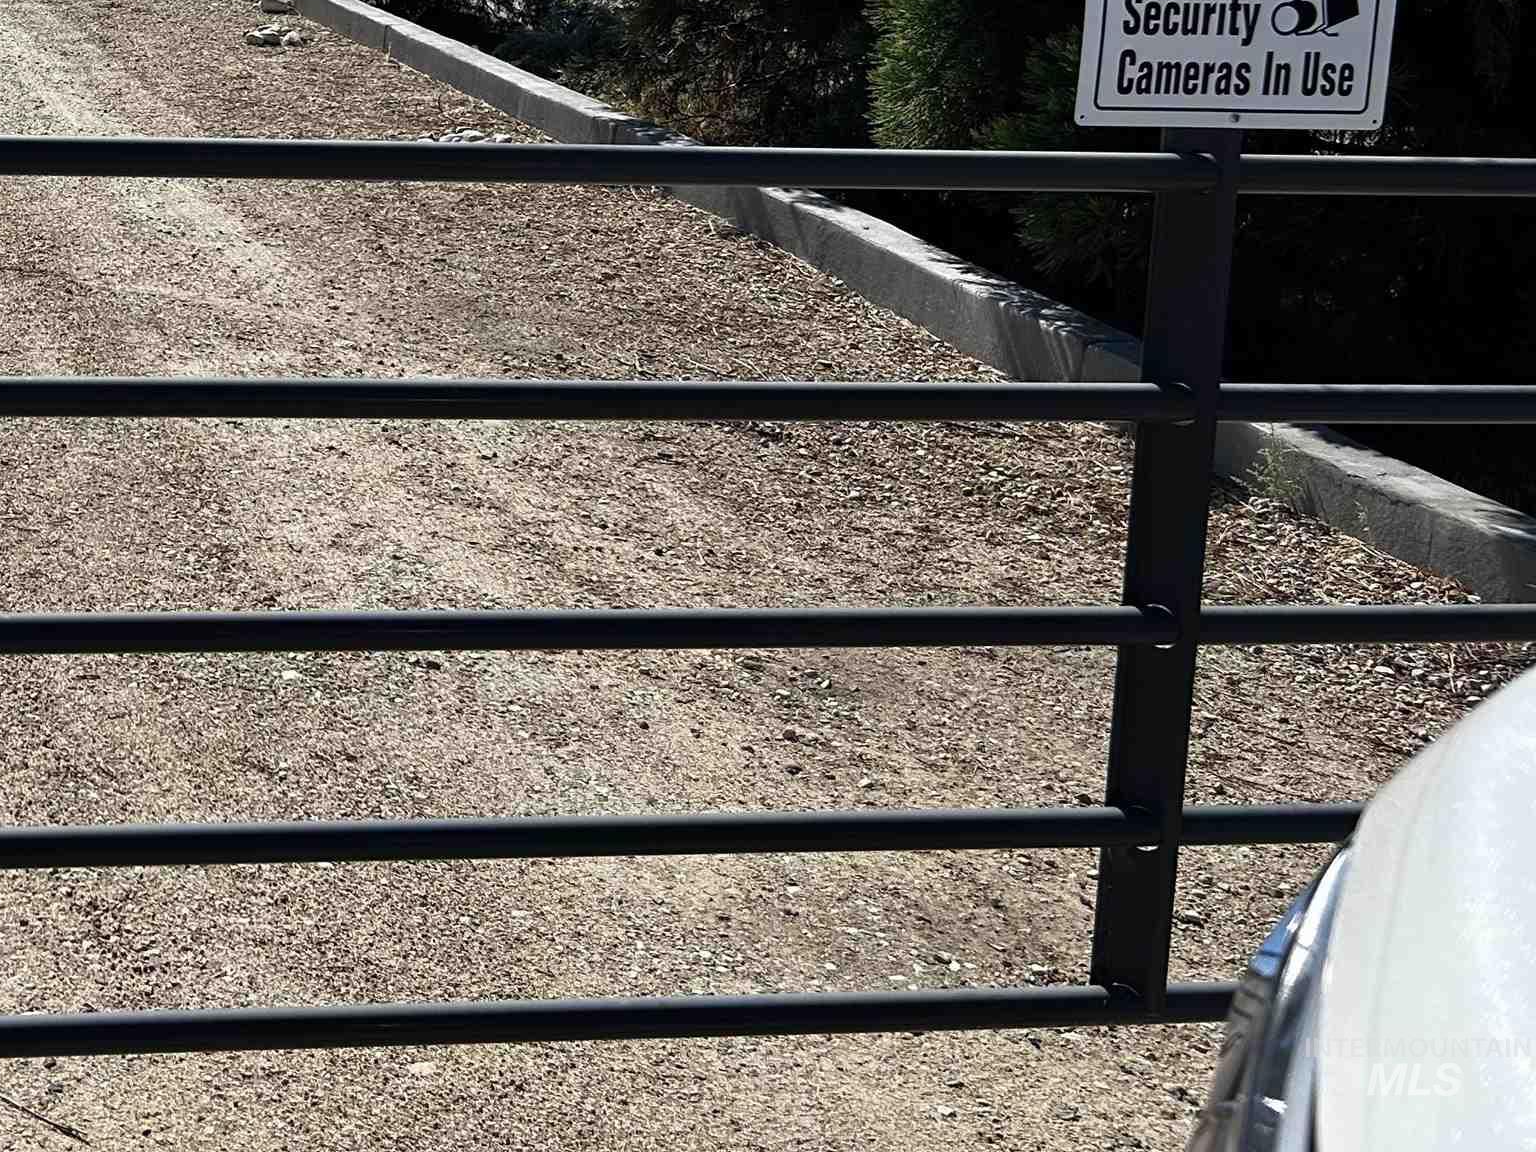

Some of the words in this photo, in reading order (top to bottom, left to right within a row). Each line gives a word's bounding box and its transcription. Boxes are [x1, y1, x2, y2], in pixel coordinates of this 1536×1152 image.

[1116, 49, 1251, 96] Cameras
[1262, 51, 1291, 96] In
[1302, 51, 1355, 97] Use
